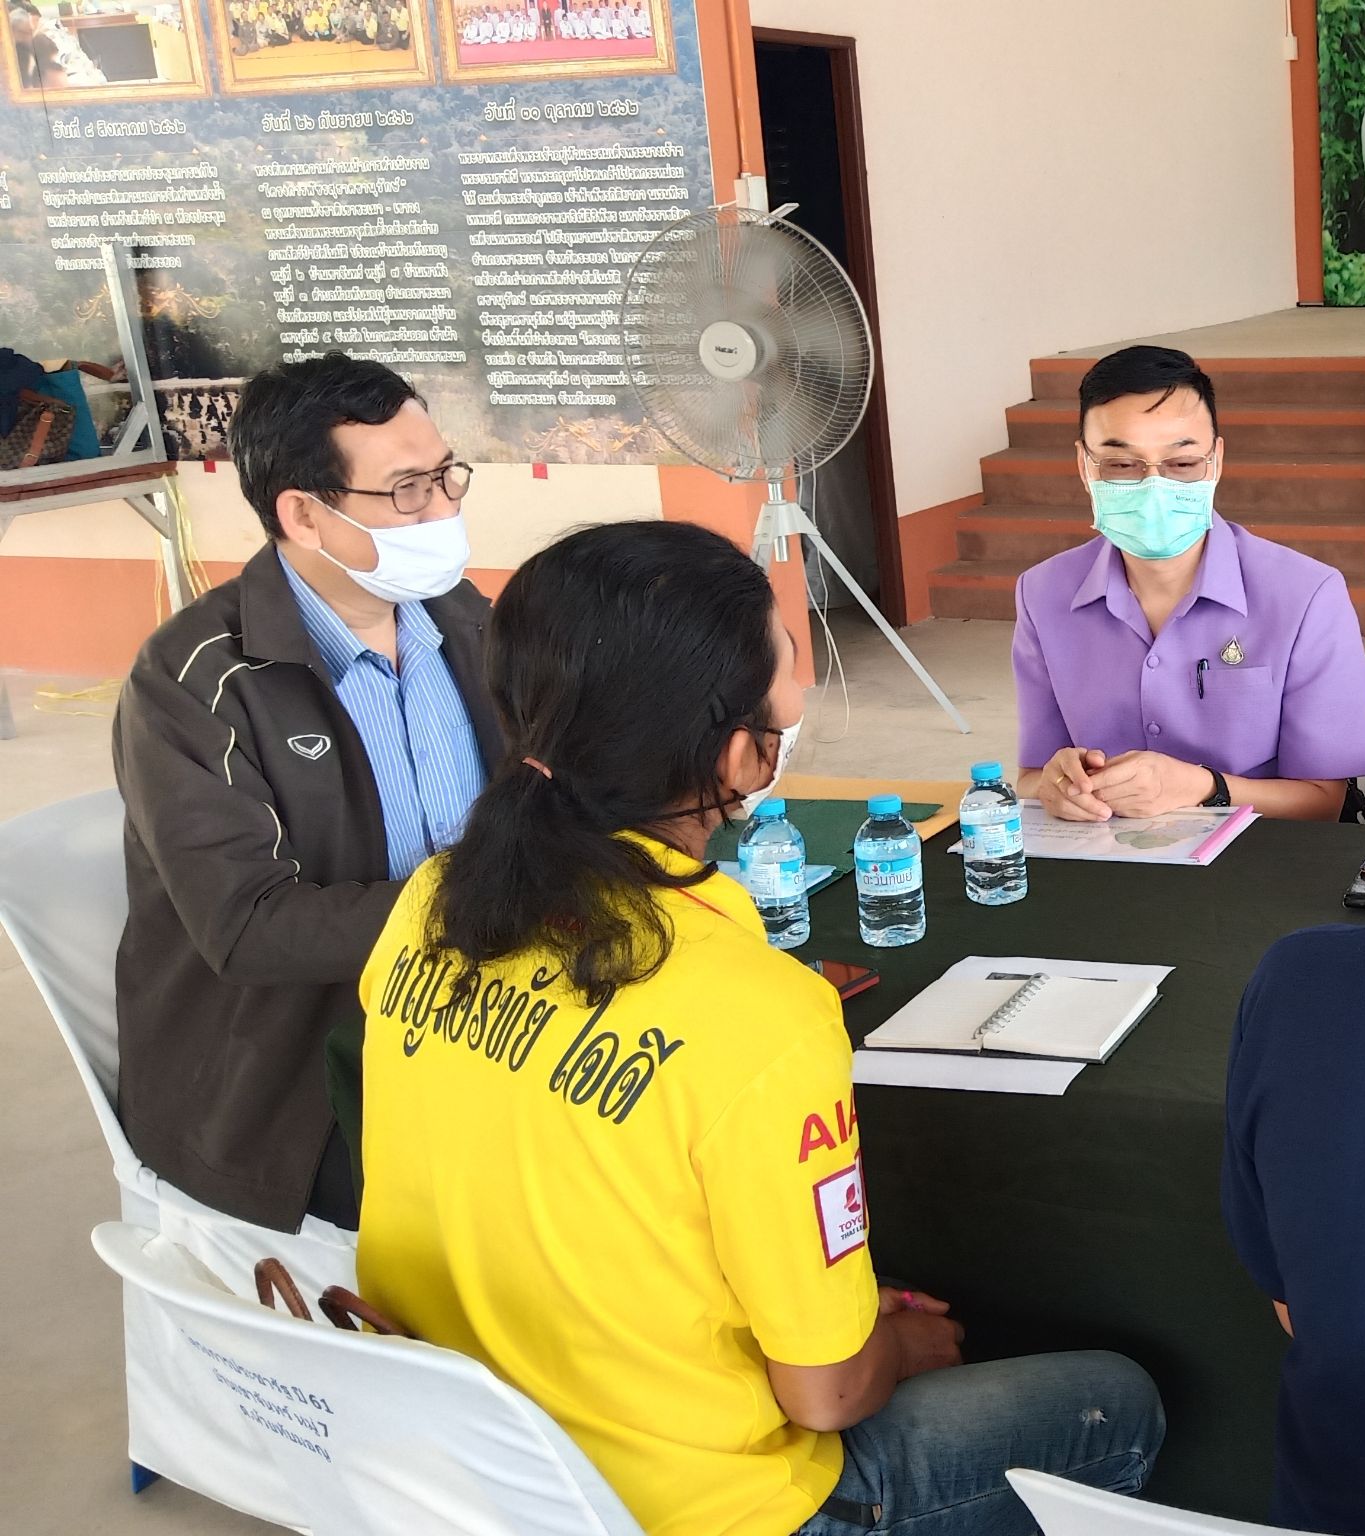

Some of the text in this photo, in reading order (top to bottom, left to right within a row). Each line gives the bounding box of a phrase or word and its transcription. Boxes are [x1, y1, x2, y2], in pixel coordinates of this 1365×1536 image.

[262, 109, 413, 132] วันที่ ๒๖ กันยายน ๒๕๖๒
[484, 97, 515, 121] วันที่
[545, 101, 594, 123] ตุลาคม
[598, 99, 639, 116] ๒๕๖๒
[53, 116, 81, 139] วันที่
[97, 119, 147, 138] สิงหาคม
[151, 118, 186, 135] ๒๕๖๒
[462, 190, 476, 205] ให้
[308, 1394, 334, 1415] 61
